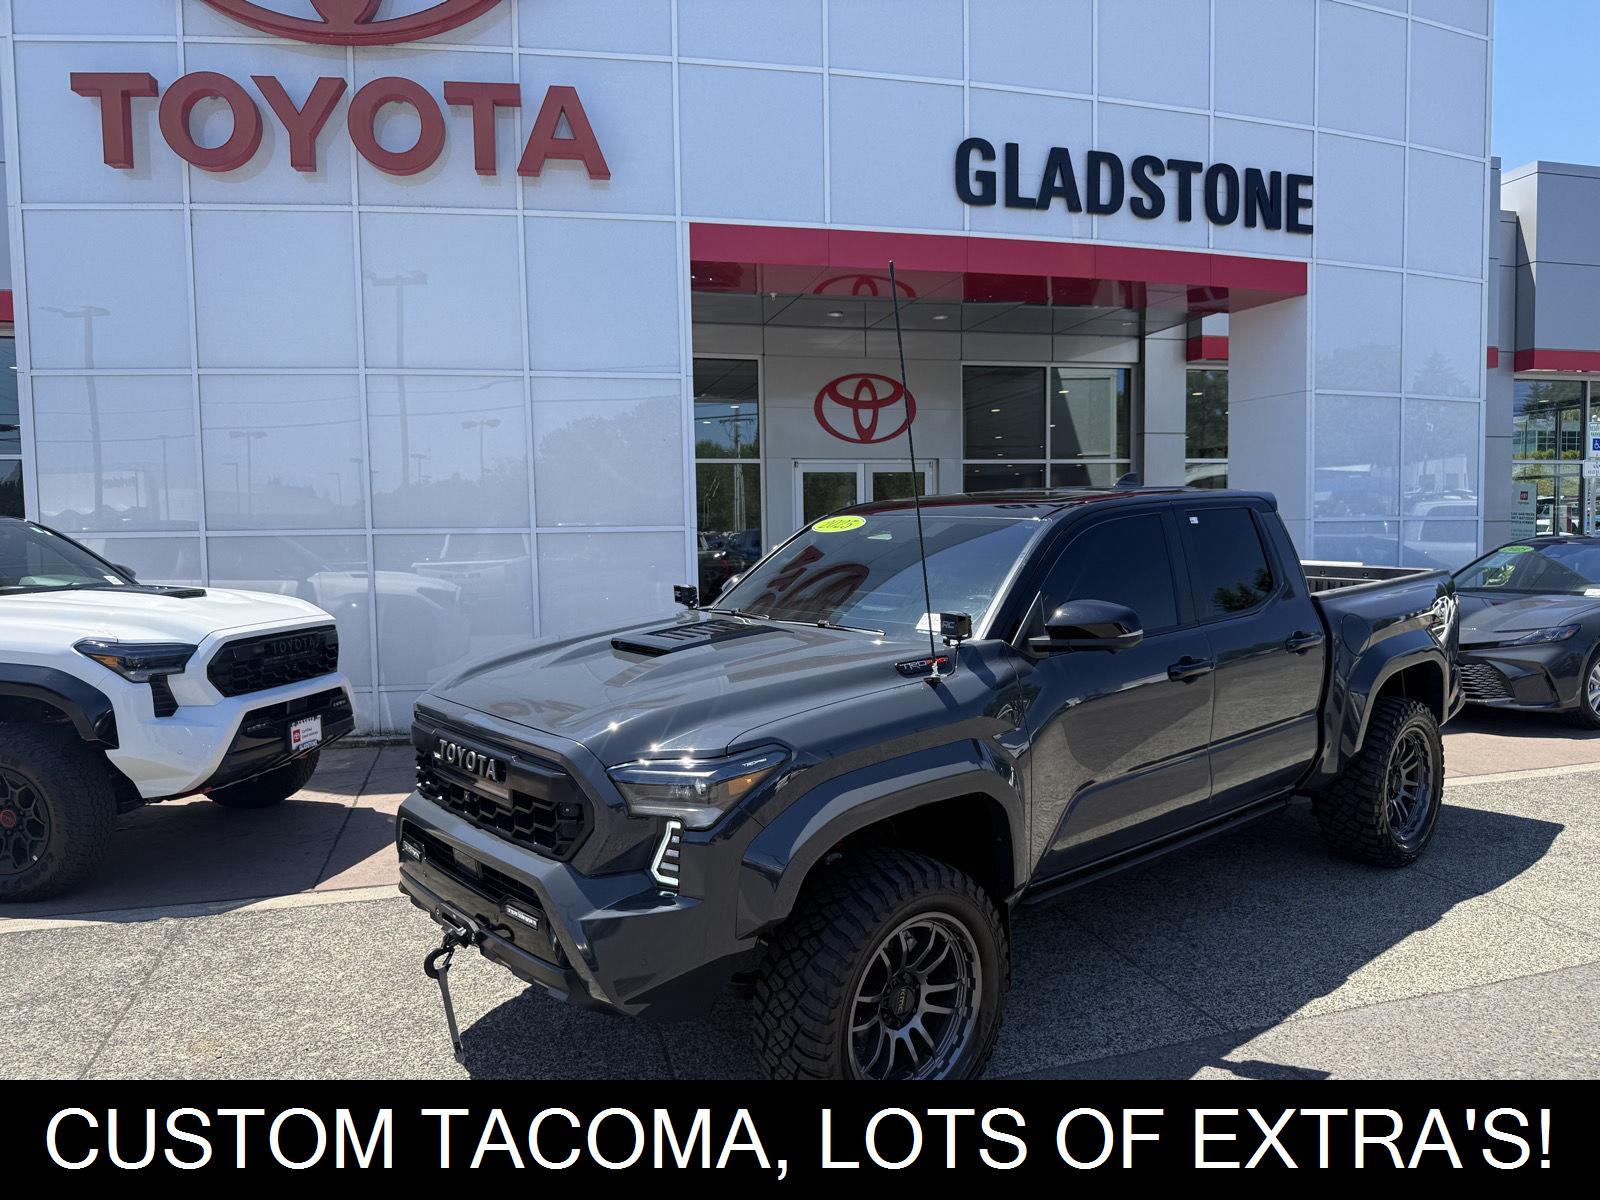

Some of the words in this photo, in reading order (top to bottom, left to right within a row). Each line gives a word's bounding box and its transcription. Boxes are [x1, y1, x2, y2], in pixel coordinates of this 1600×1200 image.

[70, 71, 611, 181] TOYOTA
[955, 137, 1314, 235] GLADSTONE
[439, 738, 498, 781] TOYOTA
